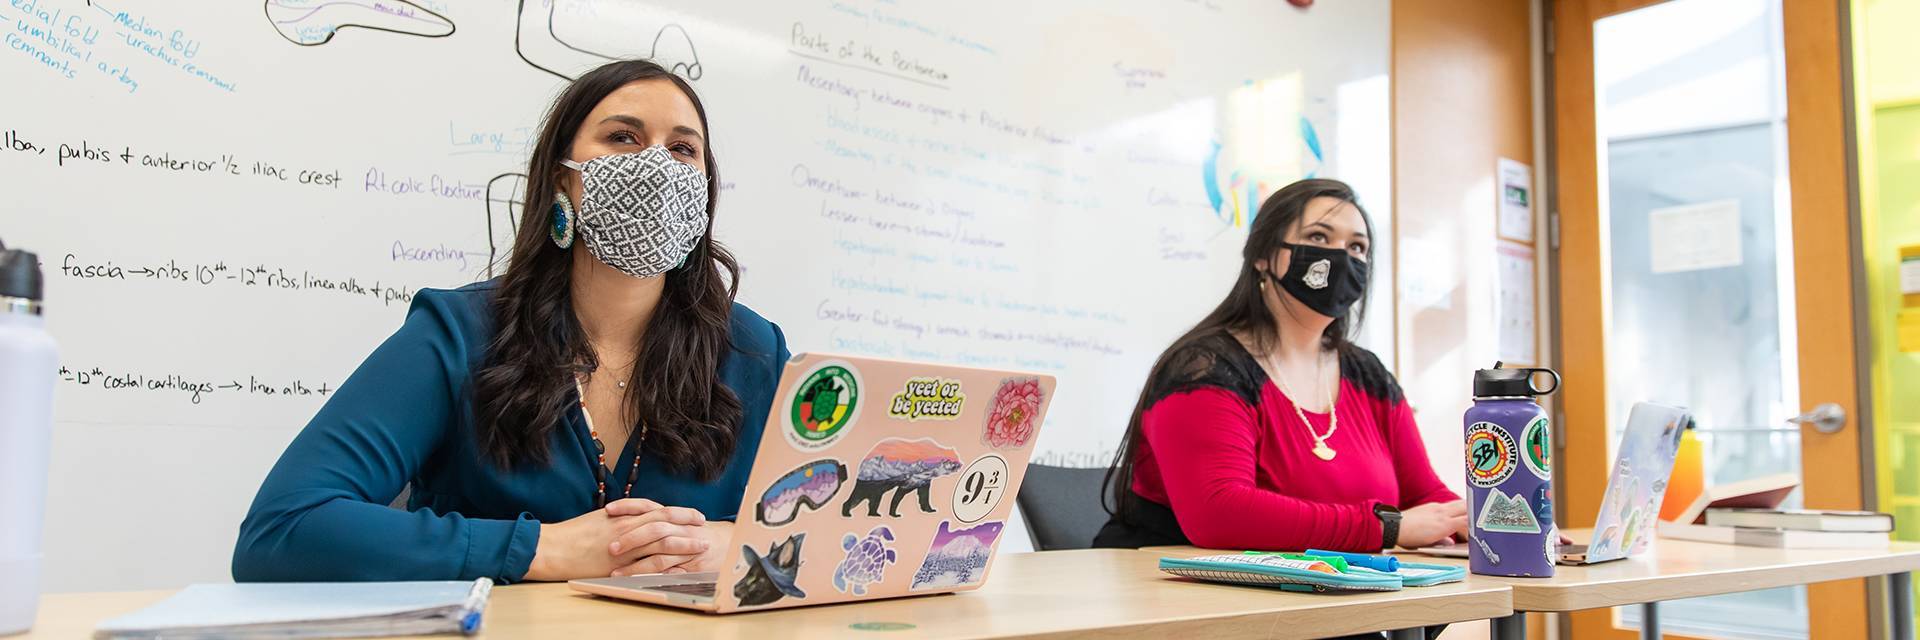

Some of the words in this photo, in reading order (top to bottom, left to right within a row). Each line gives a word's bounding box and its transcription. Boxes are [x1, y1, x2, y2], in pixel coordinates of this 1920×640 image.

[17, 19, 92, 61] umbilical
[64, 15, 99, 44] fold
[113, 11, 163, 41] Median
[169, 29, 200, 58] fold
[6, 32, 76, 79] remnants
[0, 130, 45, 155] lba,
[58, 140, 110, 167] pubis
[142, 152, 216, 174] anterior
[252, 160, 288, 181] iliac
[299, 169, 342, 189] crest
[61, 253, 125, 280] fascia
[303, 270, 336, 290] linea
[339, 277, 367, 296] alba
[392, 239, 468, 273] Ascending
[104, 374, 143, 390] costal
[147, 374, 214, 405] cartilages
[283, 380, 312, 396] alba
[892, 395, 912, 415] be
[912, 397, 963, 418] yeeted
[905, 380, 939, 400] yeet
[940, 383, 959, 398] or
[1466, 423, 1487, 444] CYCLE
[1492, 425, 1517, 466] INSTITUTE
[1472, 435, 1499, 473] SBI
